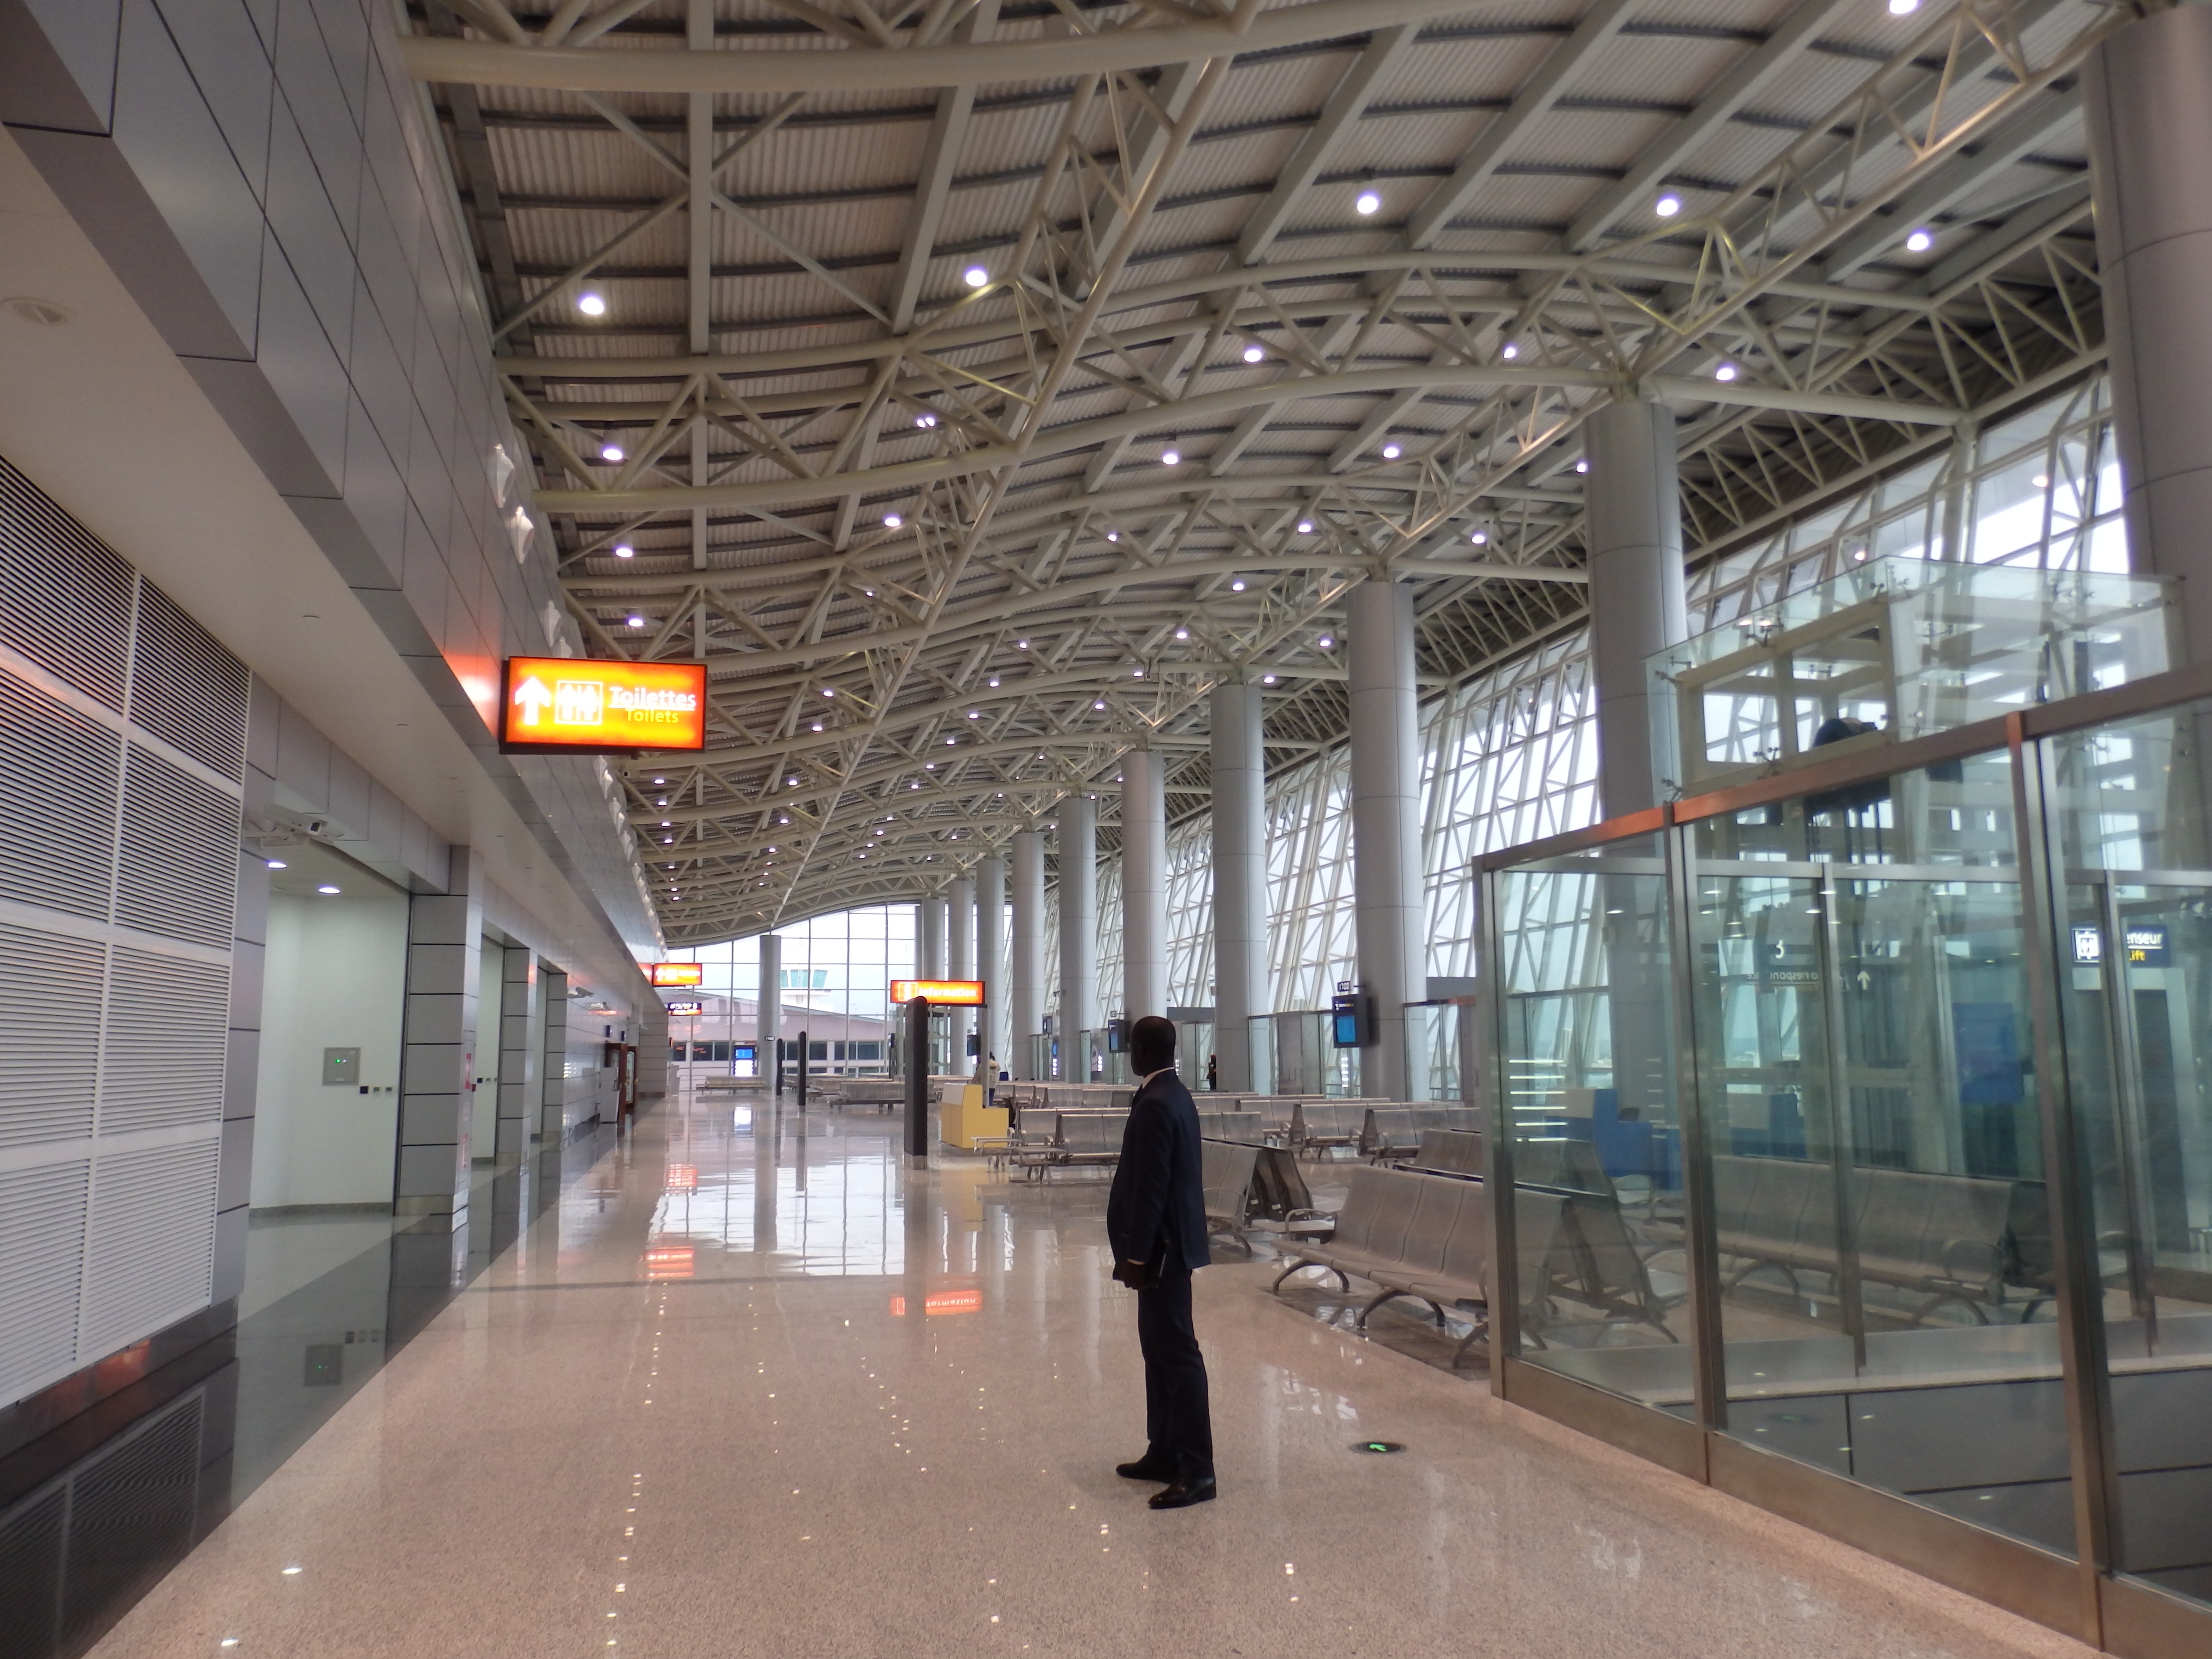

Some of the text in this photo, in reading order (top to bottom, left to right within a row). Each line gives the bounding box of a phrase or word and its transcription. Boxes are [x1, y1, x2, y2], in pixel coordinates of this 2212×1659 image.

[609, 686, 696, 708] Toilettes
[625, 709, 679, 723] Toilets
[919, 986, 977, 998] Information
